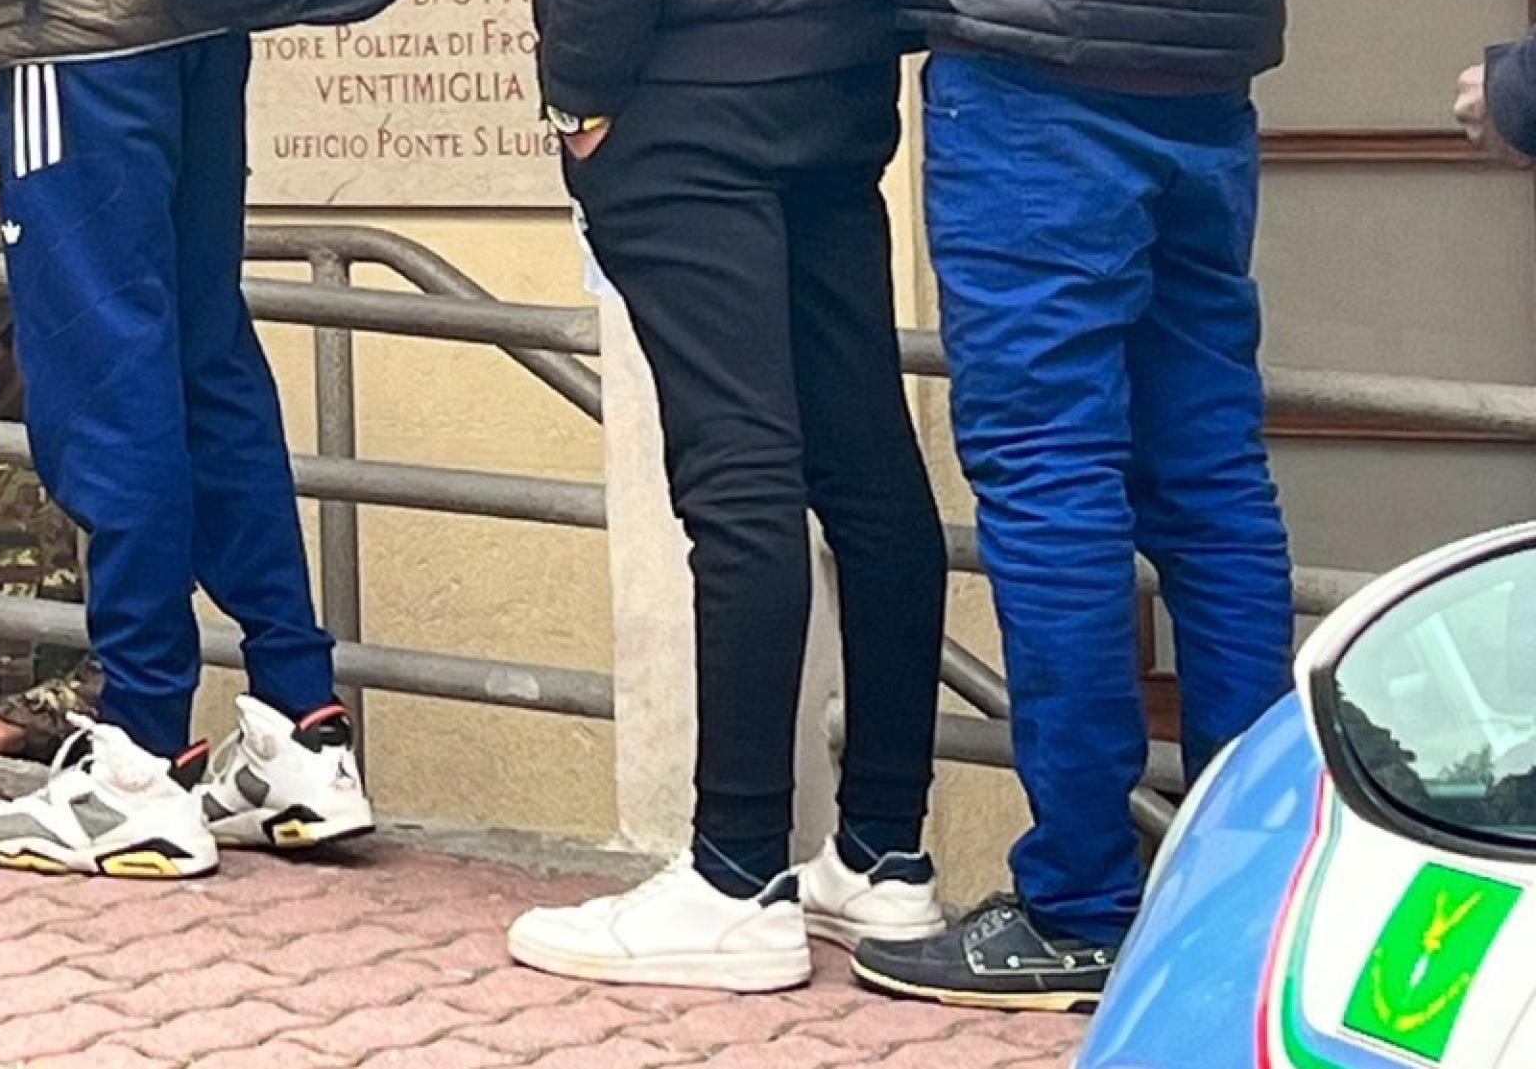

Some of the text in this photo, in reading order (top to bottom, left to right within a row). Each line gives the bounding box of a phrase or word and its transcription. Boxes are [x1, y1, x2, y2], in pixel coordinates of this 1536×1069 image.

[252, 19, 535, 60] TORE POLIZIA DI FRO
[315, 72, 525, 104] VENTIMIGLIA
[274, 135, 368, 158] UFFICIO
[377, 127, 464, 158] PONTE
[473, 125, 488, 157] S
